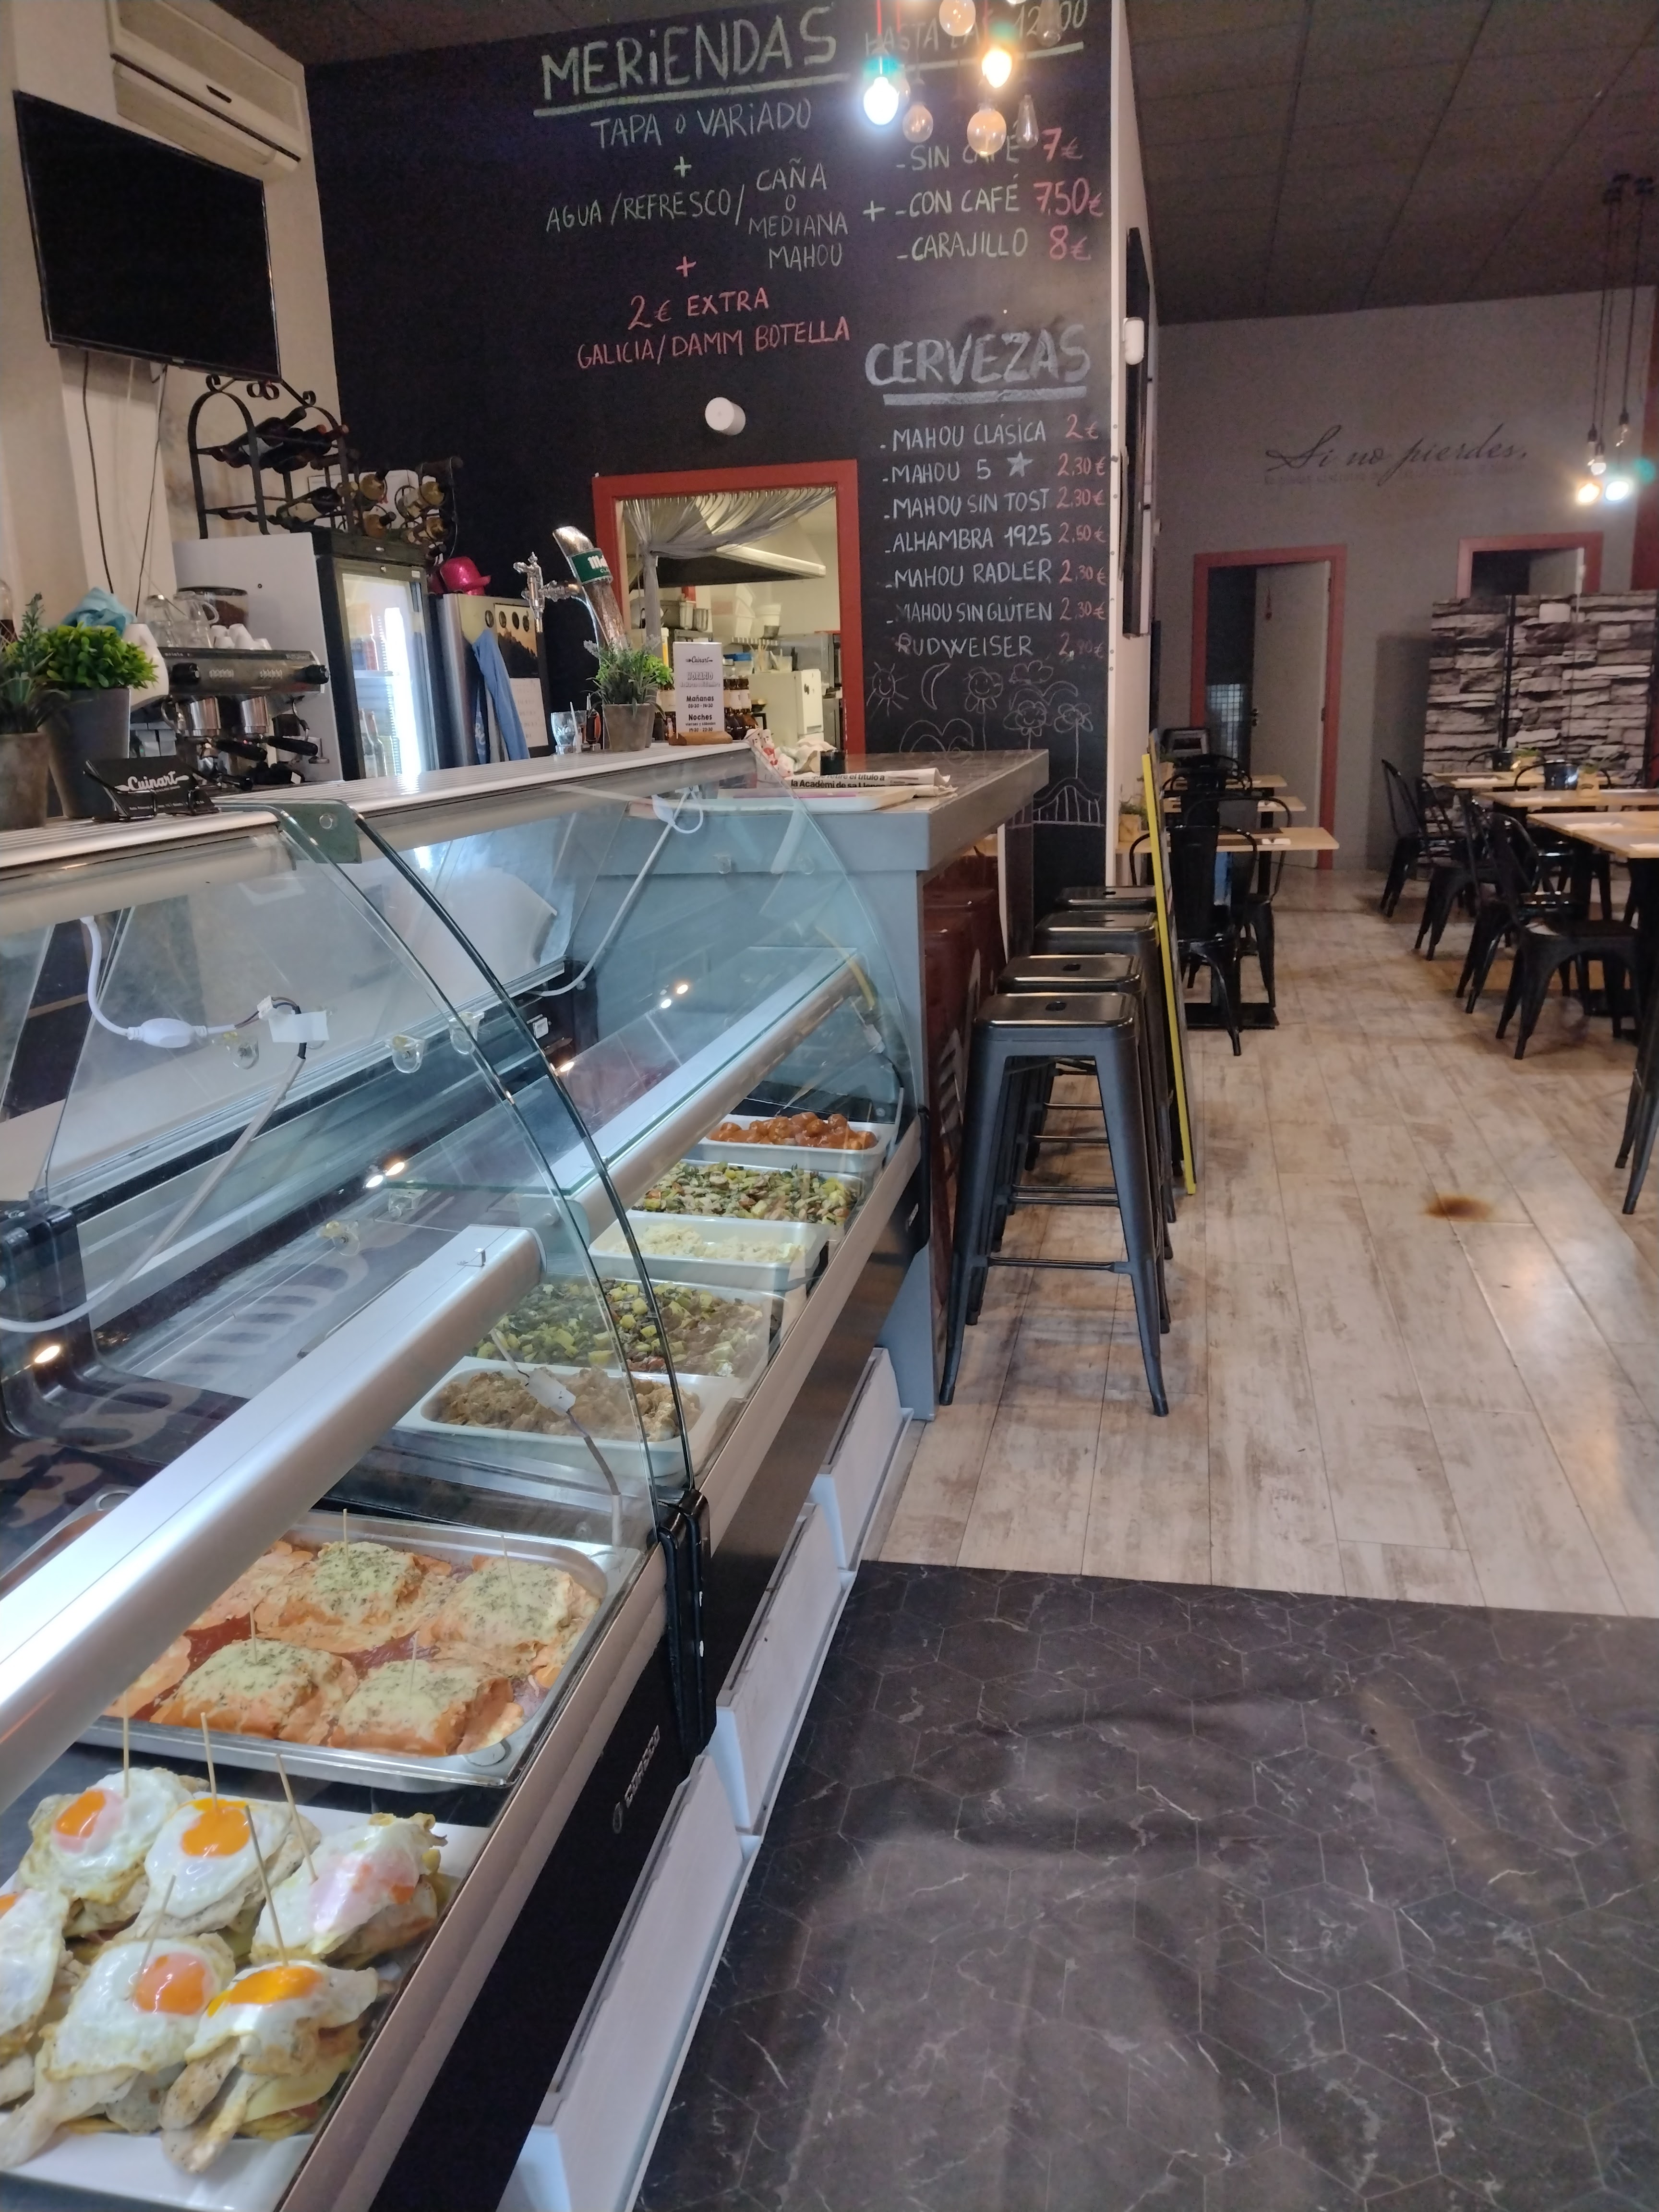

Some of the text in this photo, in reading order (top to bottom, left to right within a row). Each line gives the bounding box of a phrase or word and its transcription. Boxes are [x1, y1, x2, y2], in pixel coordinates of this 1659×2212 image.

[590, 113, 661, 149] TAPA
[757, 157, 827, 191] CAÑA
[961, 173, 1020, 212] CAFÉ
[748, 211, 848, 238] MEDIANA
[769, 242, 842, 272] MAHOU
[687, 287, 769, 317] EXTRA
[755, 316, 850, 351] BOTELLA
[865, 324, 1091, 386] CERVEZAS
[1265, 424, 1342, 472] Si
[1346, 446, 1383, 466] no
[976, 459, 992, 480] 5
[967, 493, 998, 514] SIN
[1004, 488, 1050, 513] TOST
[1004, 523, 1052, 548] 1925
[973, 558, 1052, 584] RADLER
[956, 602, 984, 623] SIN
[687, 672, 713, 681] HORARIO
[799, 780, 835, 788] Acadèmi
